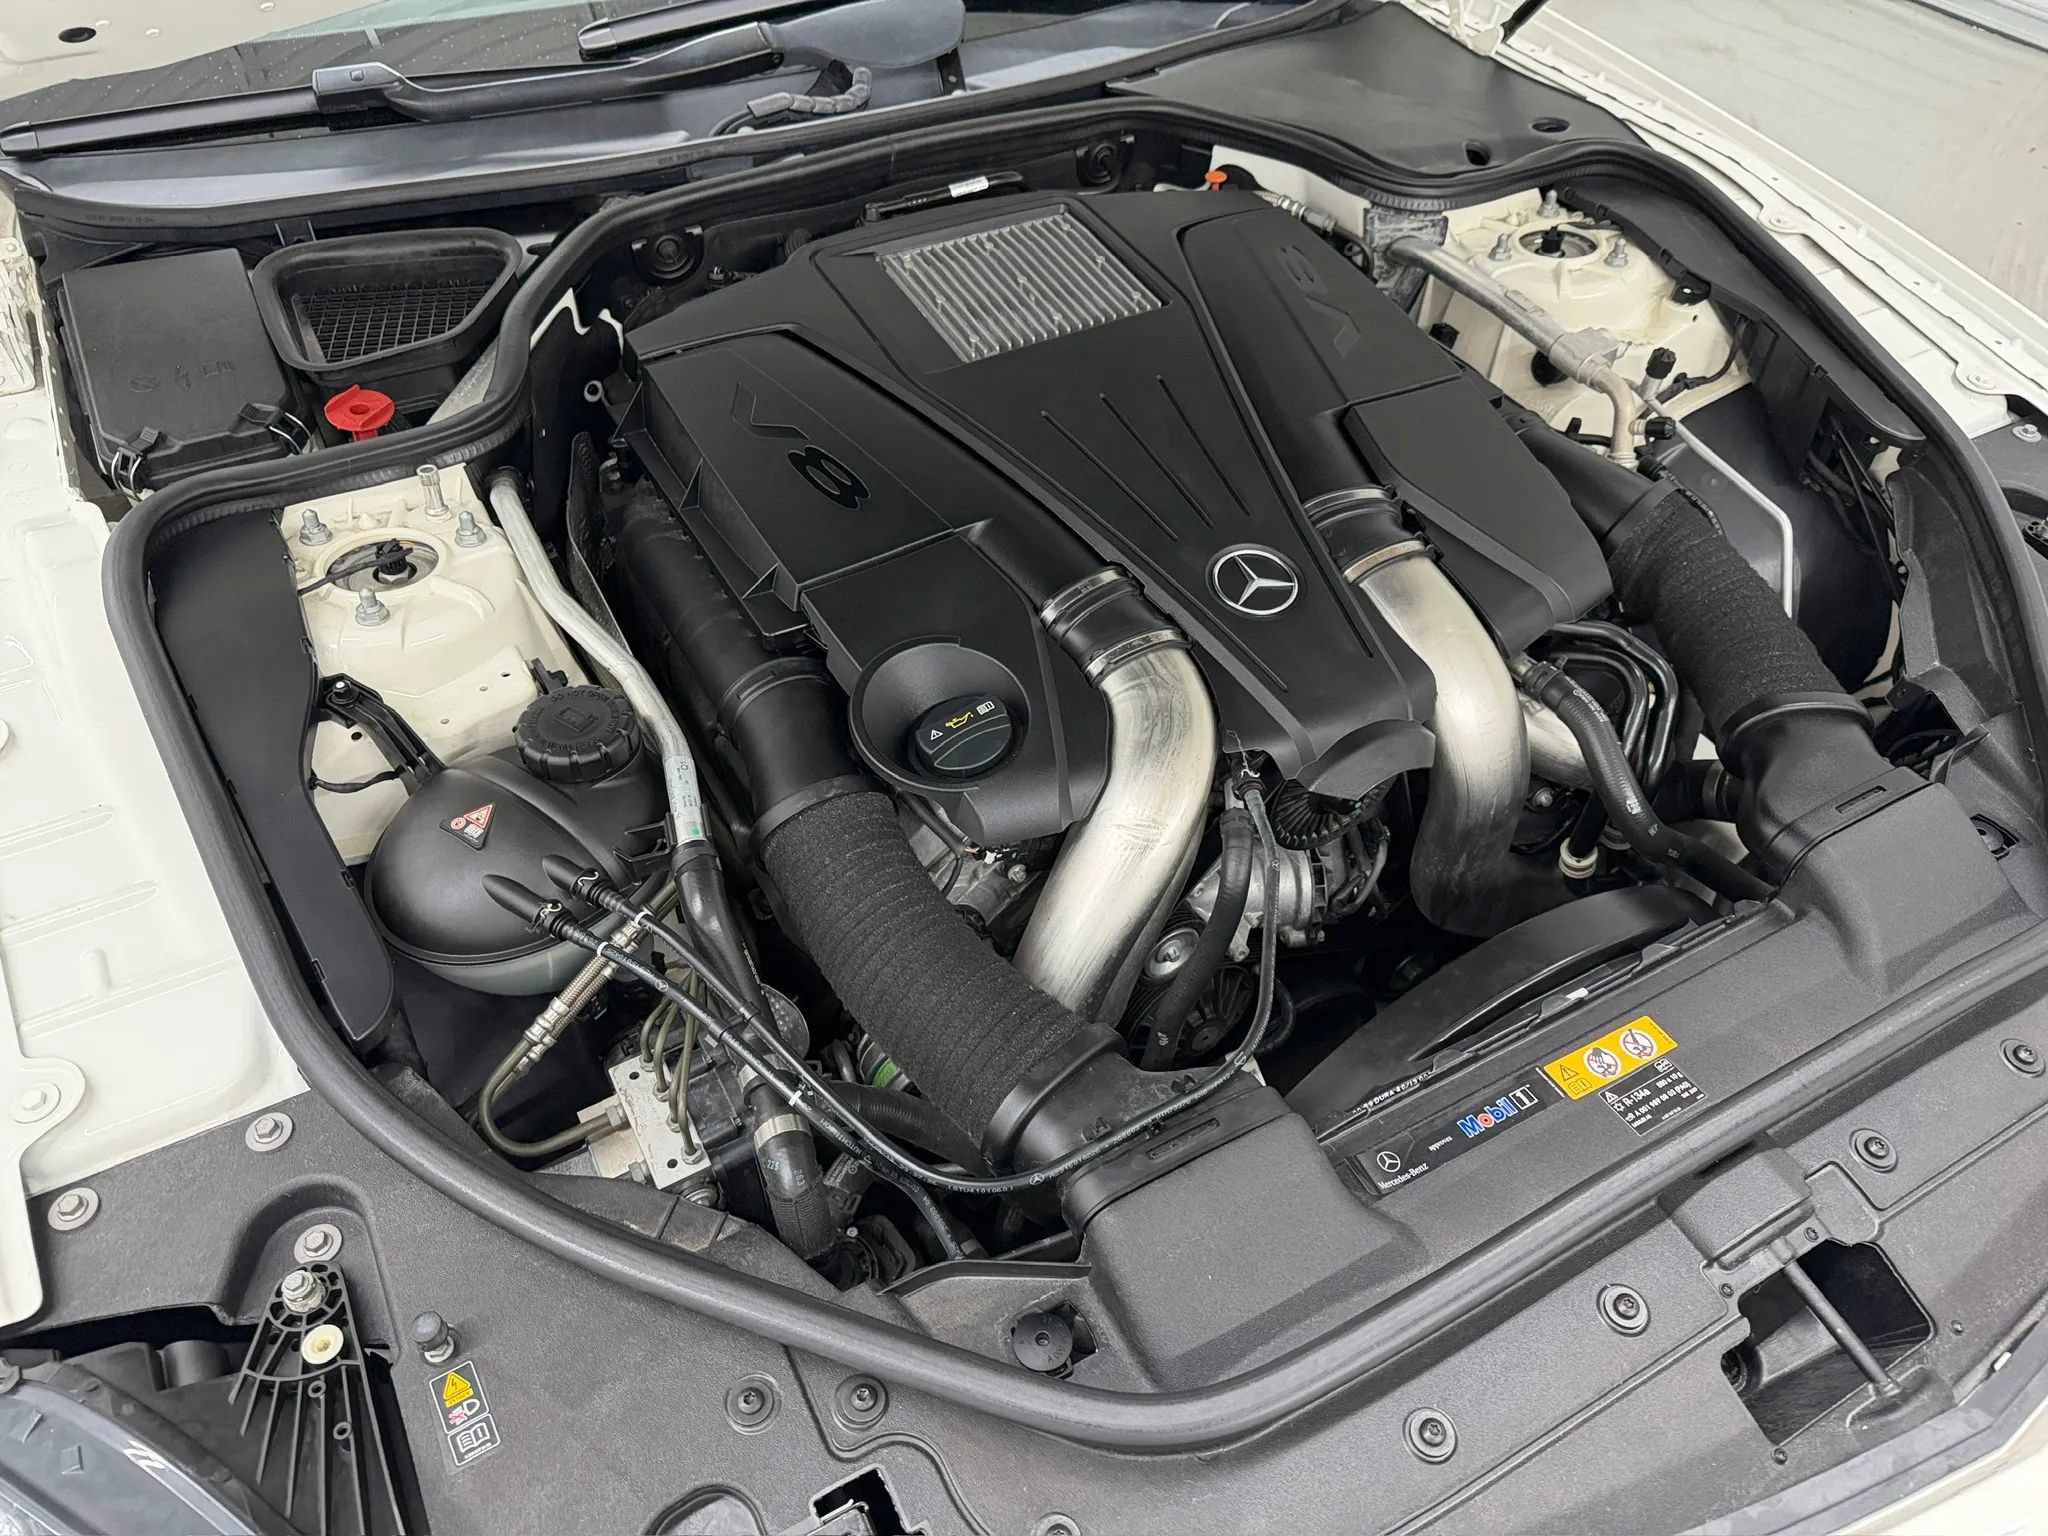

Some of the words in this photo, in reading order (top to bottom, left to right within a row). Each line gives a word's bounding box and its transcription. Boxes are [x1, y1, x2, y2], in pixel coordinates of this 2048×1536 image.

[731, 381, 871, 510] V8
[1373, 1089, 1395, 1105] DURA
[1621, 1088, 1651, 1107] R-134a
[1456, 1096, 1519, 1139] Mobil
[1428, 1136, 1453, 1152] approves
[1377, 1162, 1429, 1190] Mercedes-Benz
